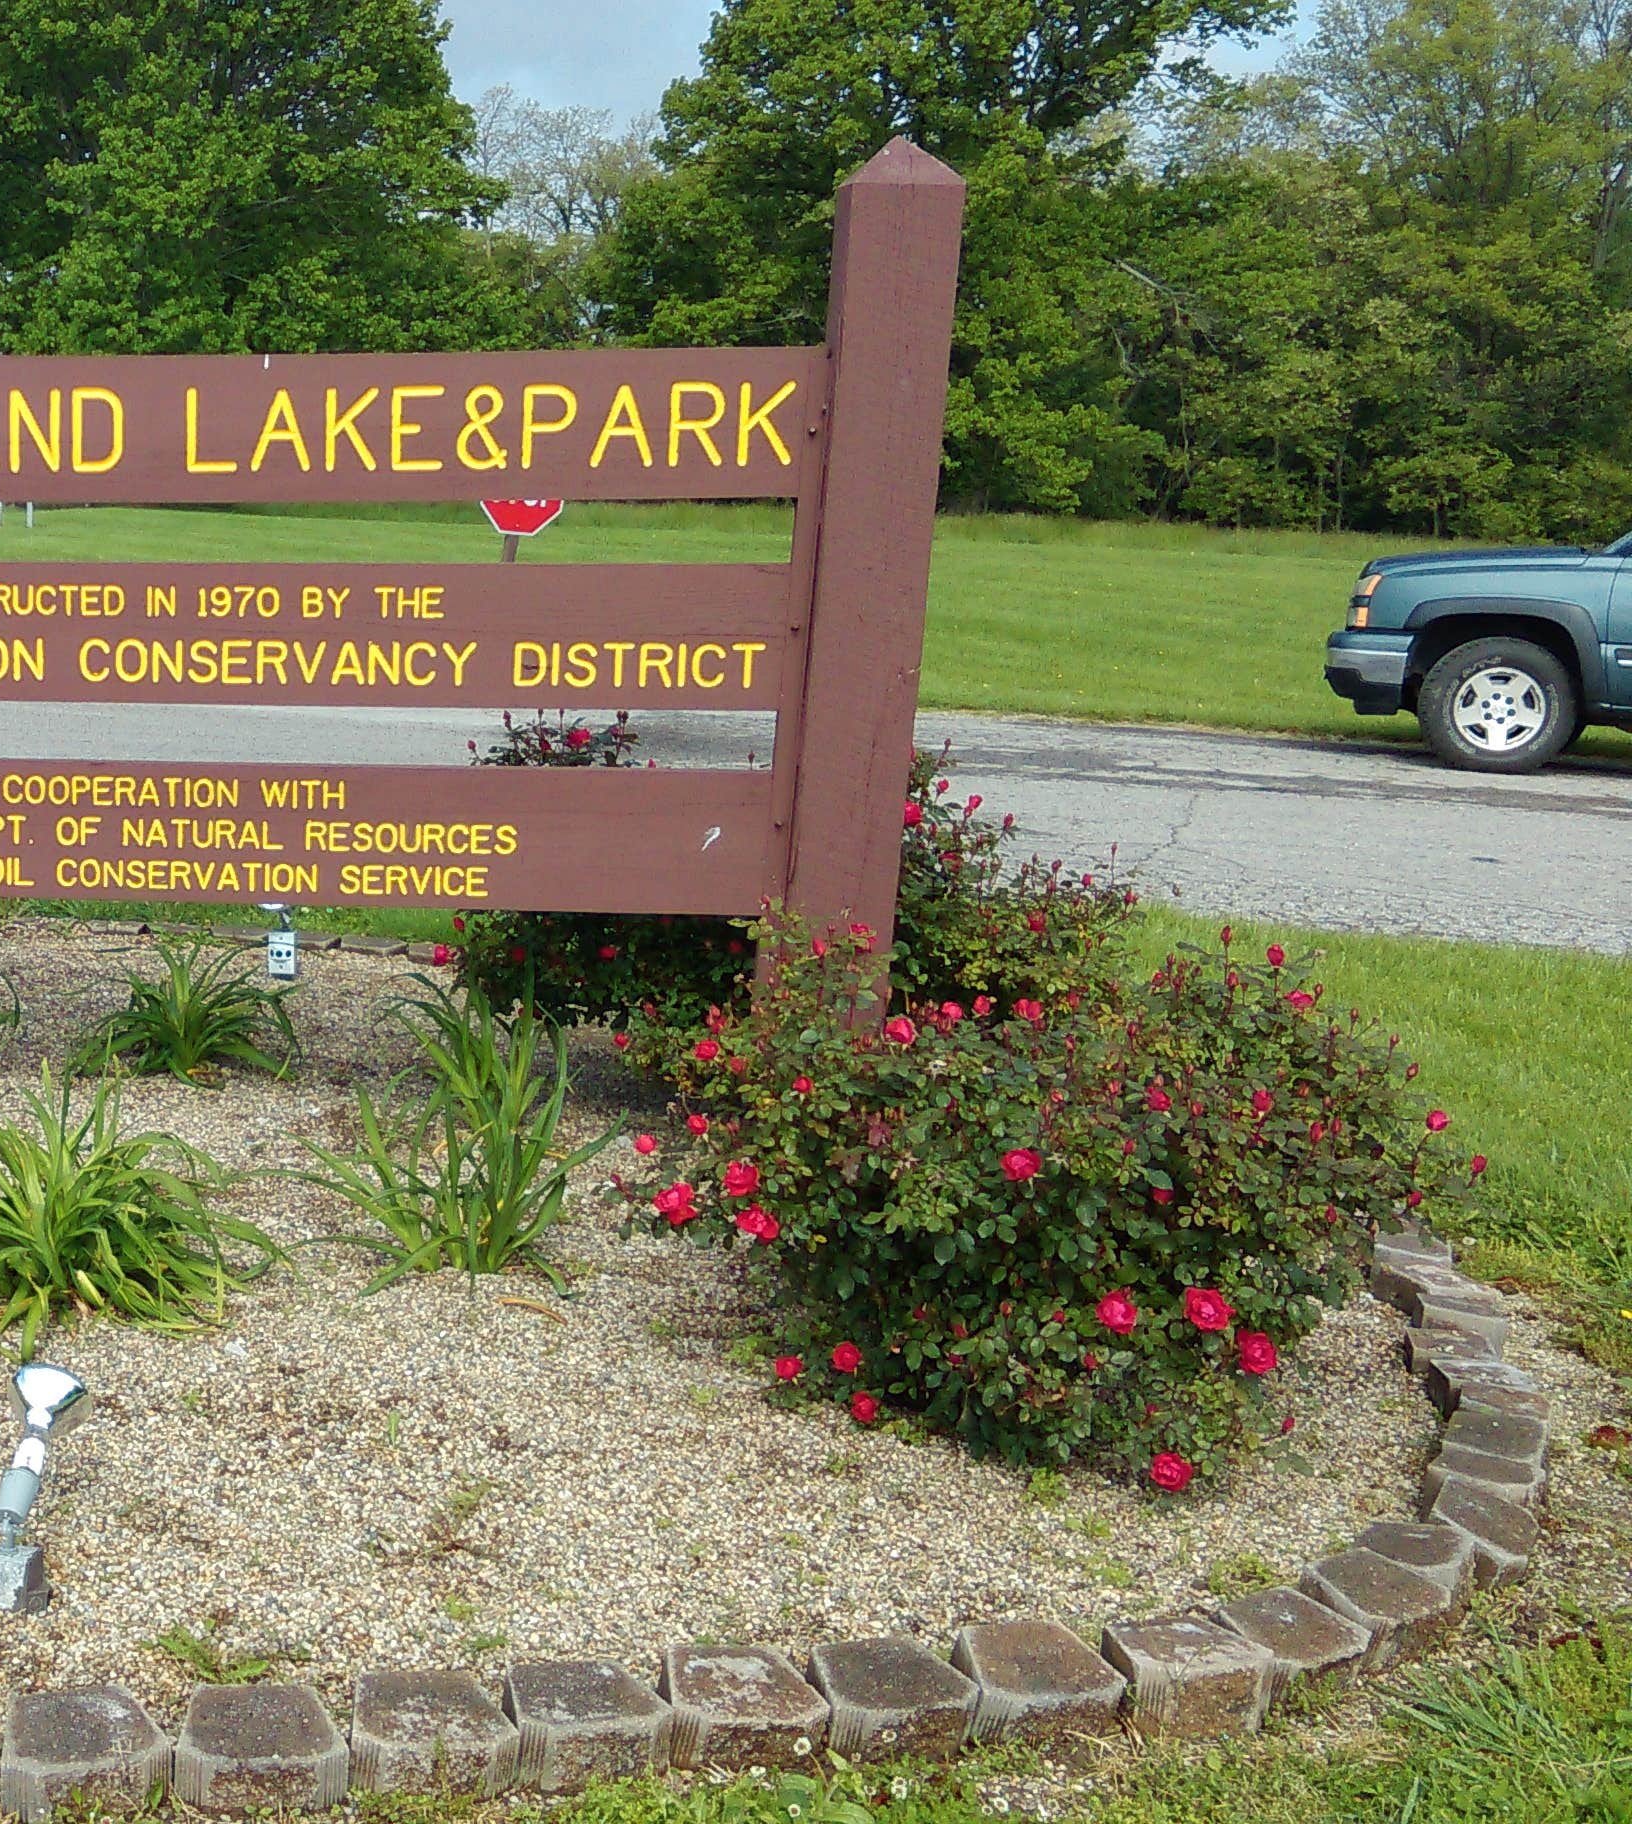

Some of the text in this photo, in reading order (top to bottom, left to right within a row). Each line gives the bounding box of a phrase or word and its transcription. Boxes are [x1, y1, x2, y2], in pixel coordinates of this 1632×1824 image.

[144, 585, 179, 619] IN
[195, 585, 283, 619] 1970
[299, 585, 352, 620] BY
[372, 585, 446, 620] THE
[77, 636, 479, 689] CONSERVANCY
[511, 640, 768, 690] DISTRICT
[0, 772, 241, 810] COOPERATION
[259, 777, 348, 811] WITH
[54, 814, 104, 848] OF
[120, 816, 286, 853] NATURAL
[302, 818, 520, 857] RESOURCES
[54, 856, 321, 895] CONSERVATION
[337, 862, 490, 899] SERVICE
